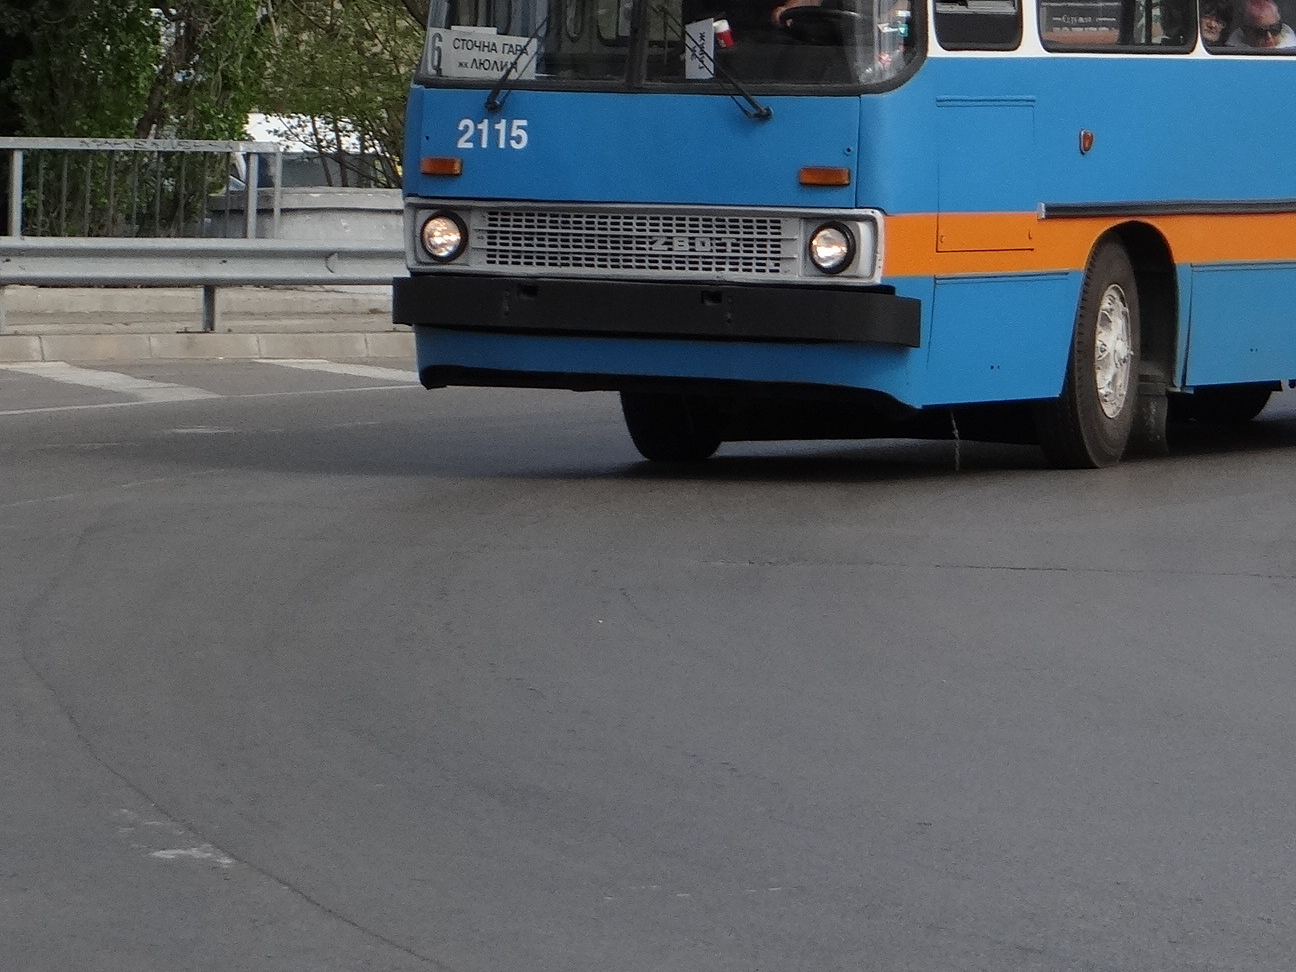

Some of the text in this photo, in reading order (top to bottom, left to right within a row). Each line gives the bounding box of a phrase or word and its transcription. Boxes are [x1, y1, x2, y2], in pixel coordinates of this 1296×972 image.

[431, 32, 443, 71] 6
[452, 37, 498, 54] СТОЧНА
[457, 118, 529, 150] 2115
